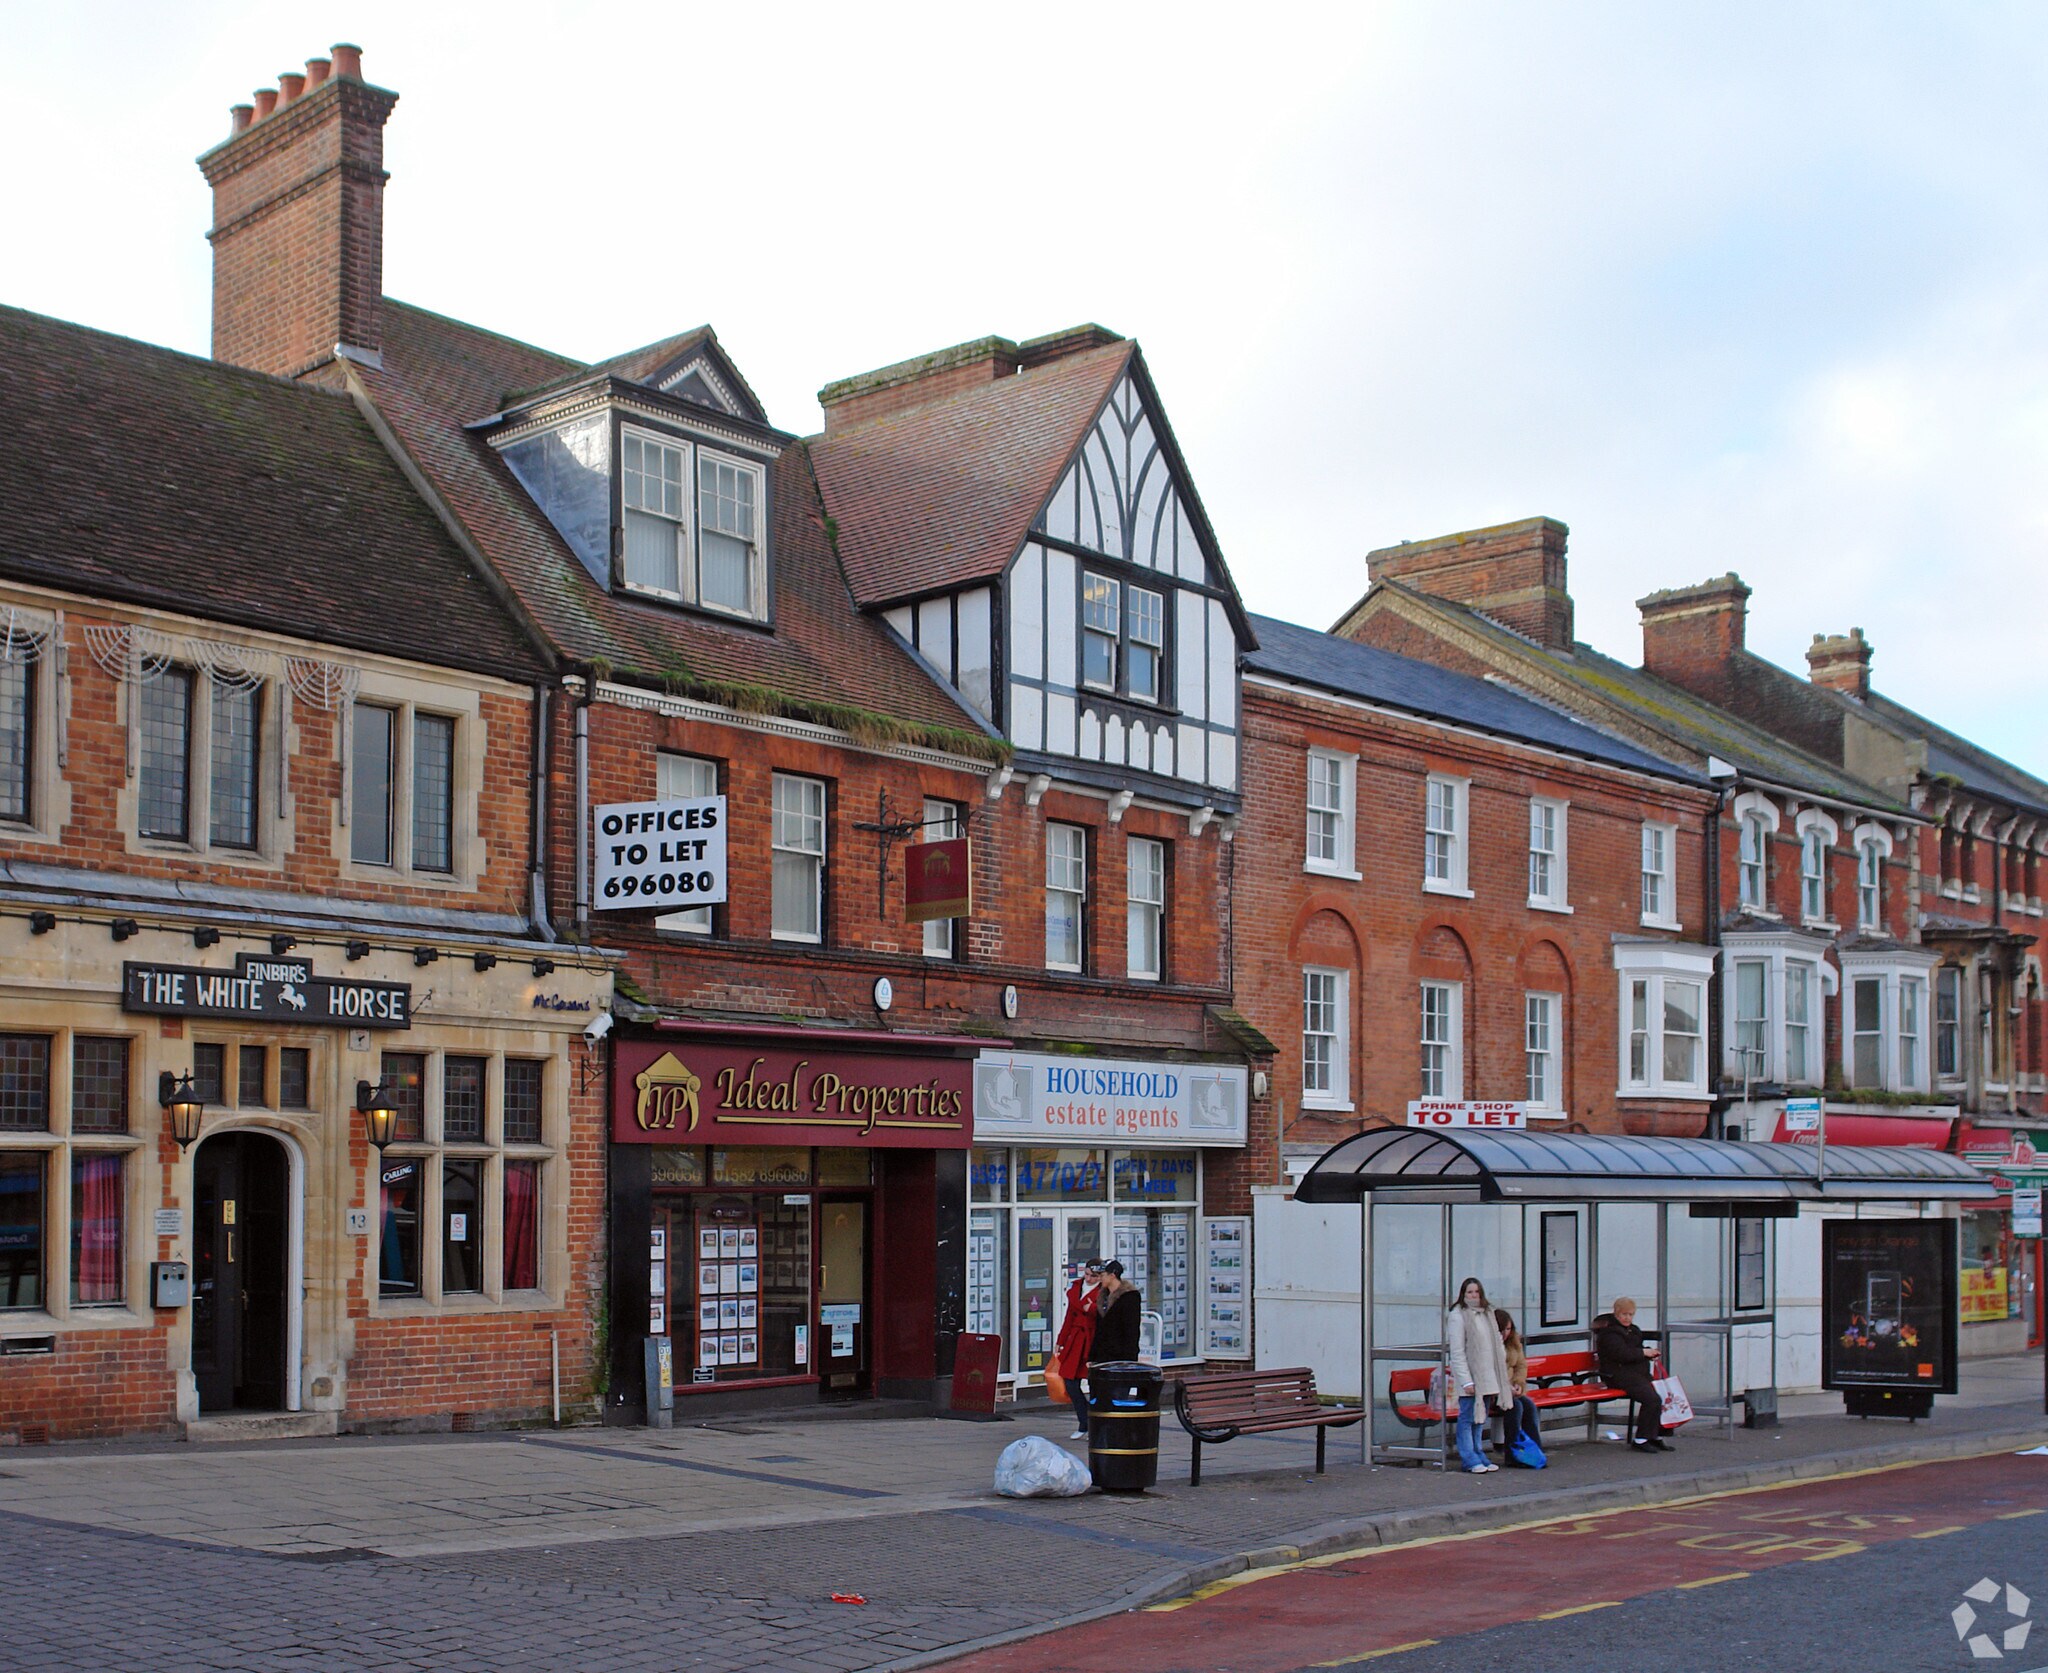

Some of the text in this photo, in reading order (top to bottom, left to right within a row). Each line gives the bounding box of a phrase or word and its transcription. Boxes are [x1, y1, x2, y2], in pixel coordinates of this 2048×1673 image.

[602, 807, 718, 836] OFFICES
[611, 839, 708, 866] TO LET
[604, 871, 714, 898] 696080
[246, 961, 307, 984] FINBAR'S
[137, 971, 406, 1021] THE WHITE HORSE
[1046, 1066, 1178, 1099] HOUSEHOLD
[717, 1058, 963, 1136] Ideal Properties
[1420, 1102, 1514, 1110] PRIME SHOP
[1045, 1101, 1178, 1133] estate agents
[1413, 1111, 1521, 1126] TO LET
[382, 1165, 413, 1183] CARLING
[714, 1167, 755, 1183] 01582
[1018, 1160, 1102, 1192] 477077
[1114, 1158, 1194, 1174] OPEN 7 DAYS
[1144, 1179, 1178, 1194] WEEK
[350, 1214, 366, 1229] 13
